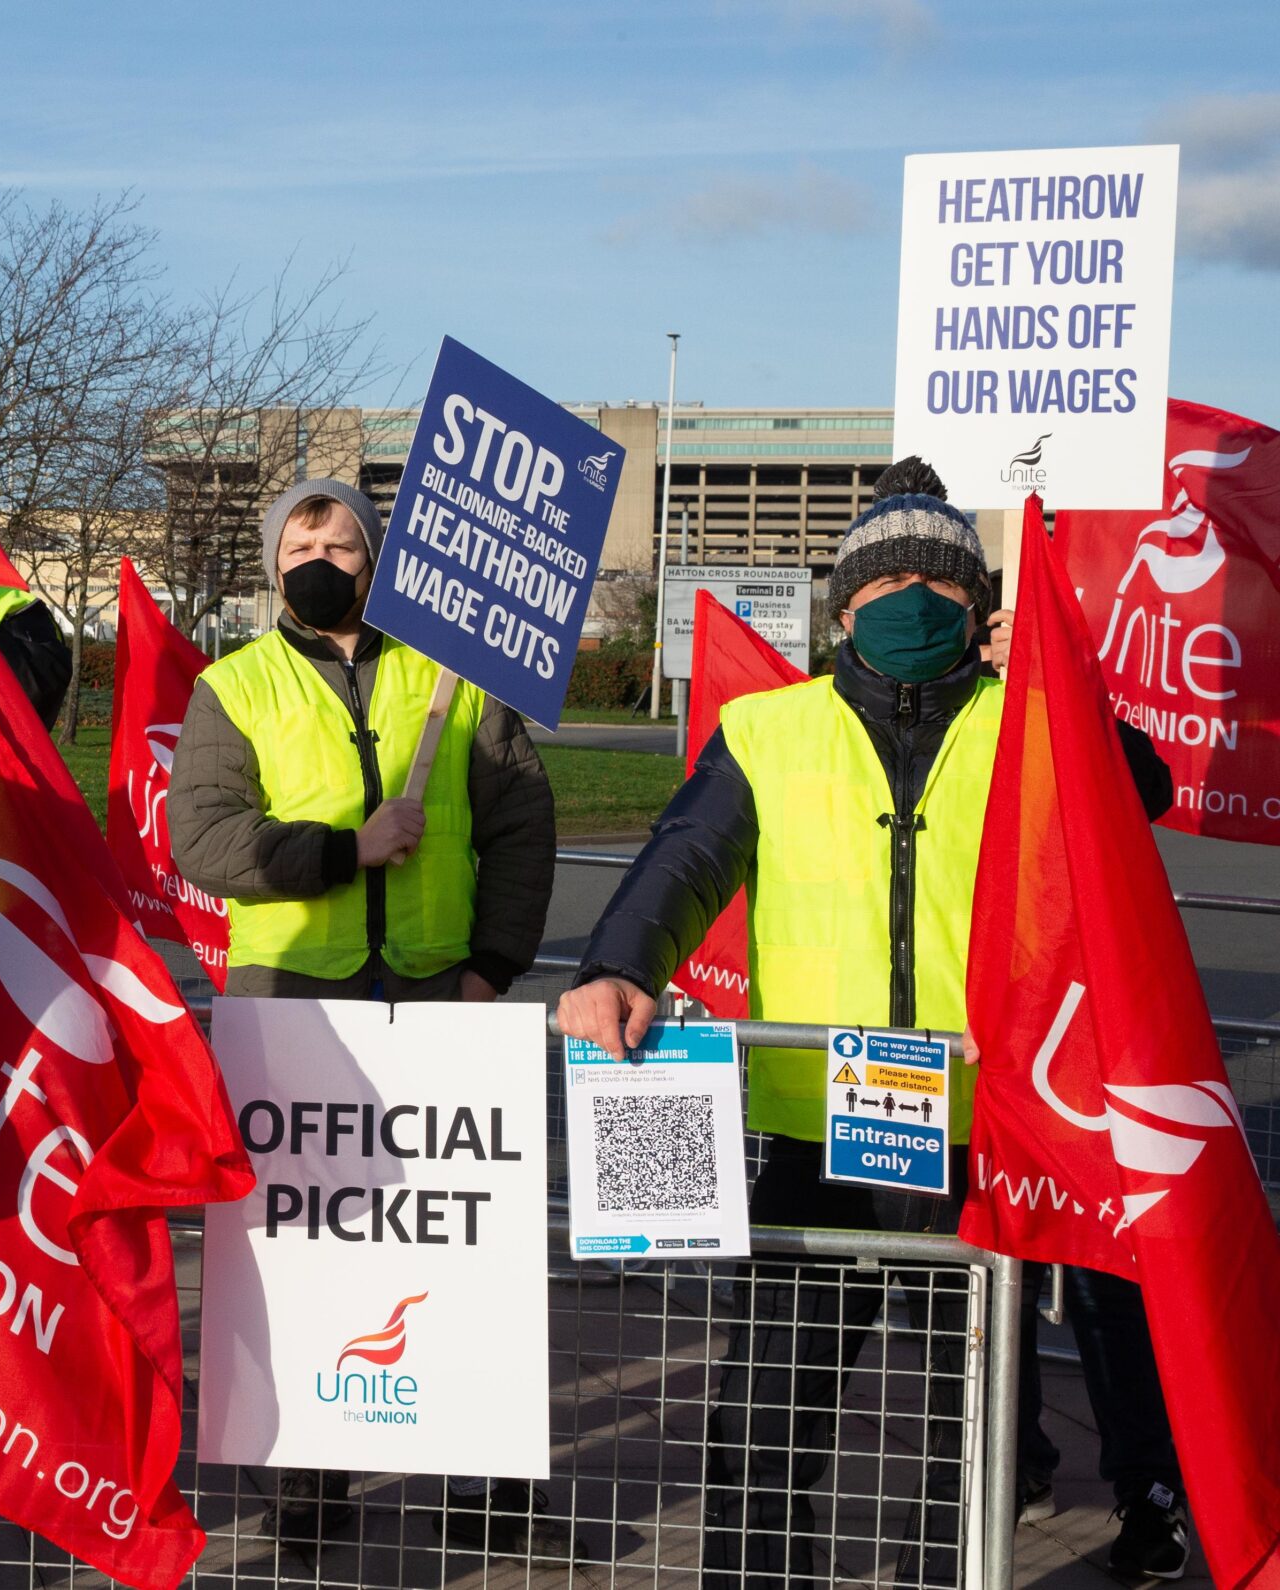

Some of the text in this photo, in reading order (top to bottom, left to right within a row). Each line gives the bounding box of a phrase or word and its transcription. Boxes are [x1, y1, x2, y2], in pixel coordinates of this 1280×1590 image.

[938, 172, 1144, 224] HEATHROW
[950, 238, 1123, 287] GET YOUR
[935, 304, 1136, 351] HANDS OFF
[927, 368, 1137, 414] OUR WAGES
[433, 393, 570, 534] STOP THE
[421, 464, 587, 579] BILLIONAIRE-BACKED
[407, 494, 577, 625] HEATHROW
[668, 568, 808, 579] HATTON CROSS ROUNDABOUT
[737, 586, 794, 596] Terminal 2 3
[753, 601, 791, 609] Business
[394, 550, 560, 680] WAGE CUTS
[753, 622, 794, 631] Long stay
[570, 1051, 584, 1060] THE
[587, 1051, 615, 1060] SPREA
[632, 1050, 688, 1060] CORONAVIRUS
[870, 1039, 942, 1055] One way system
[890, 1052, 932, 1064] operation
[879, 1068, 932, 1082] Please keep
[880, 1078, 898, 1087] safe
[900, 1081, 938, 1093] distance
[239, 1100, 521, 1161] OFFICIAL
[835, 1122, 940, 1153] Entrance
[861, 1152, 912, 1176] only
[266, 1183, 491, 1246] PICKET
